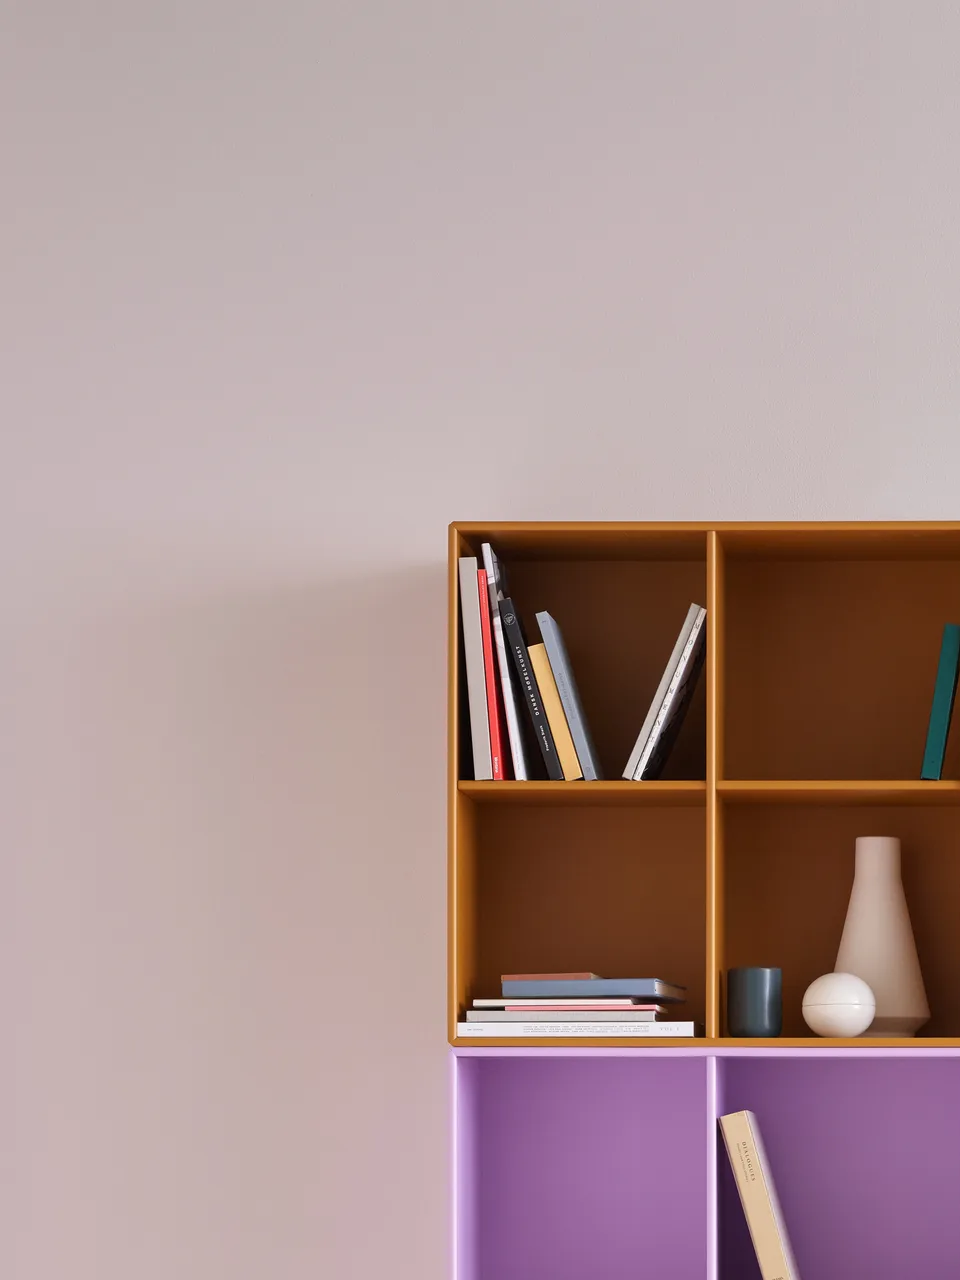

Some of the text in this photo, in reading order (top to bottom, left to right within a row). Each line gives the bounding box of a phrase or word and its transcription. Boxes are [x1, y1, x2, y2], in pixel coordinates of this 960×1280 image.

[515, 645, 540, 716] DANSK MØBELKUNST
[741, 1141, 757, 1182] DIALOGUES
